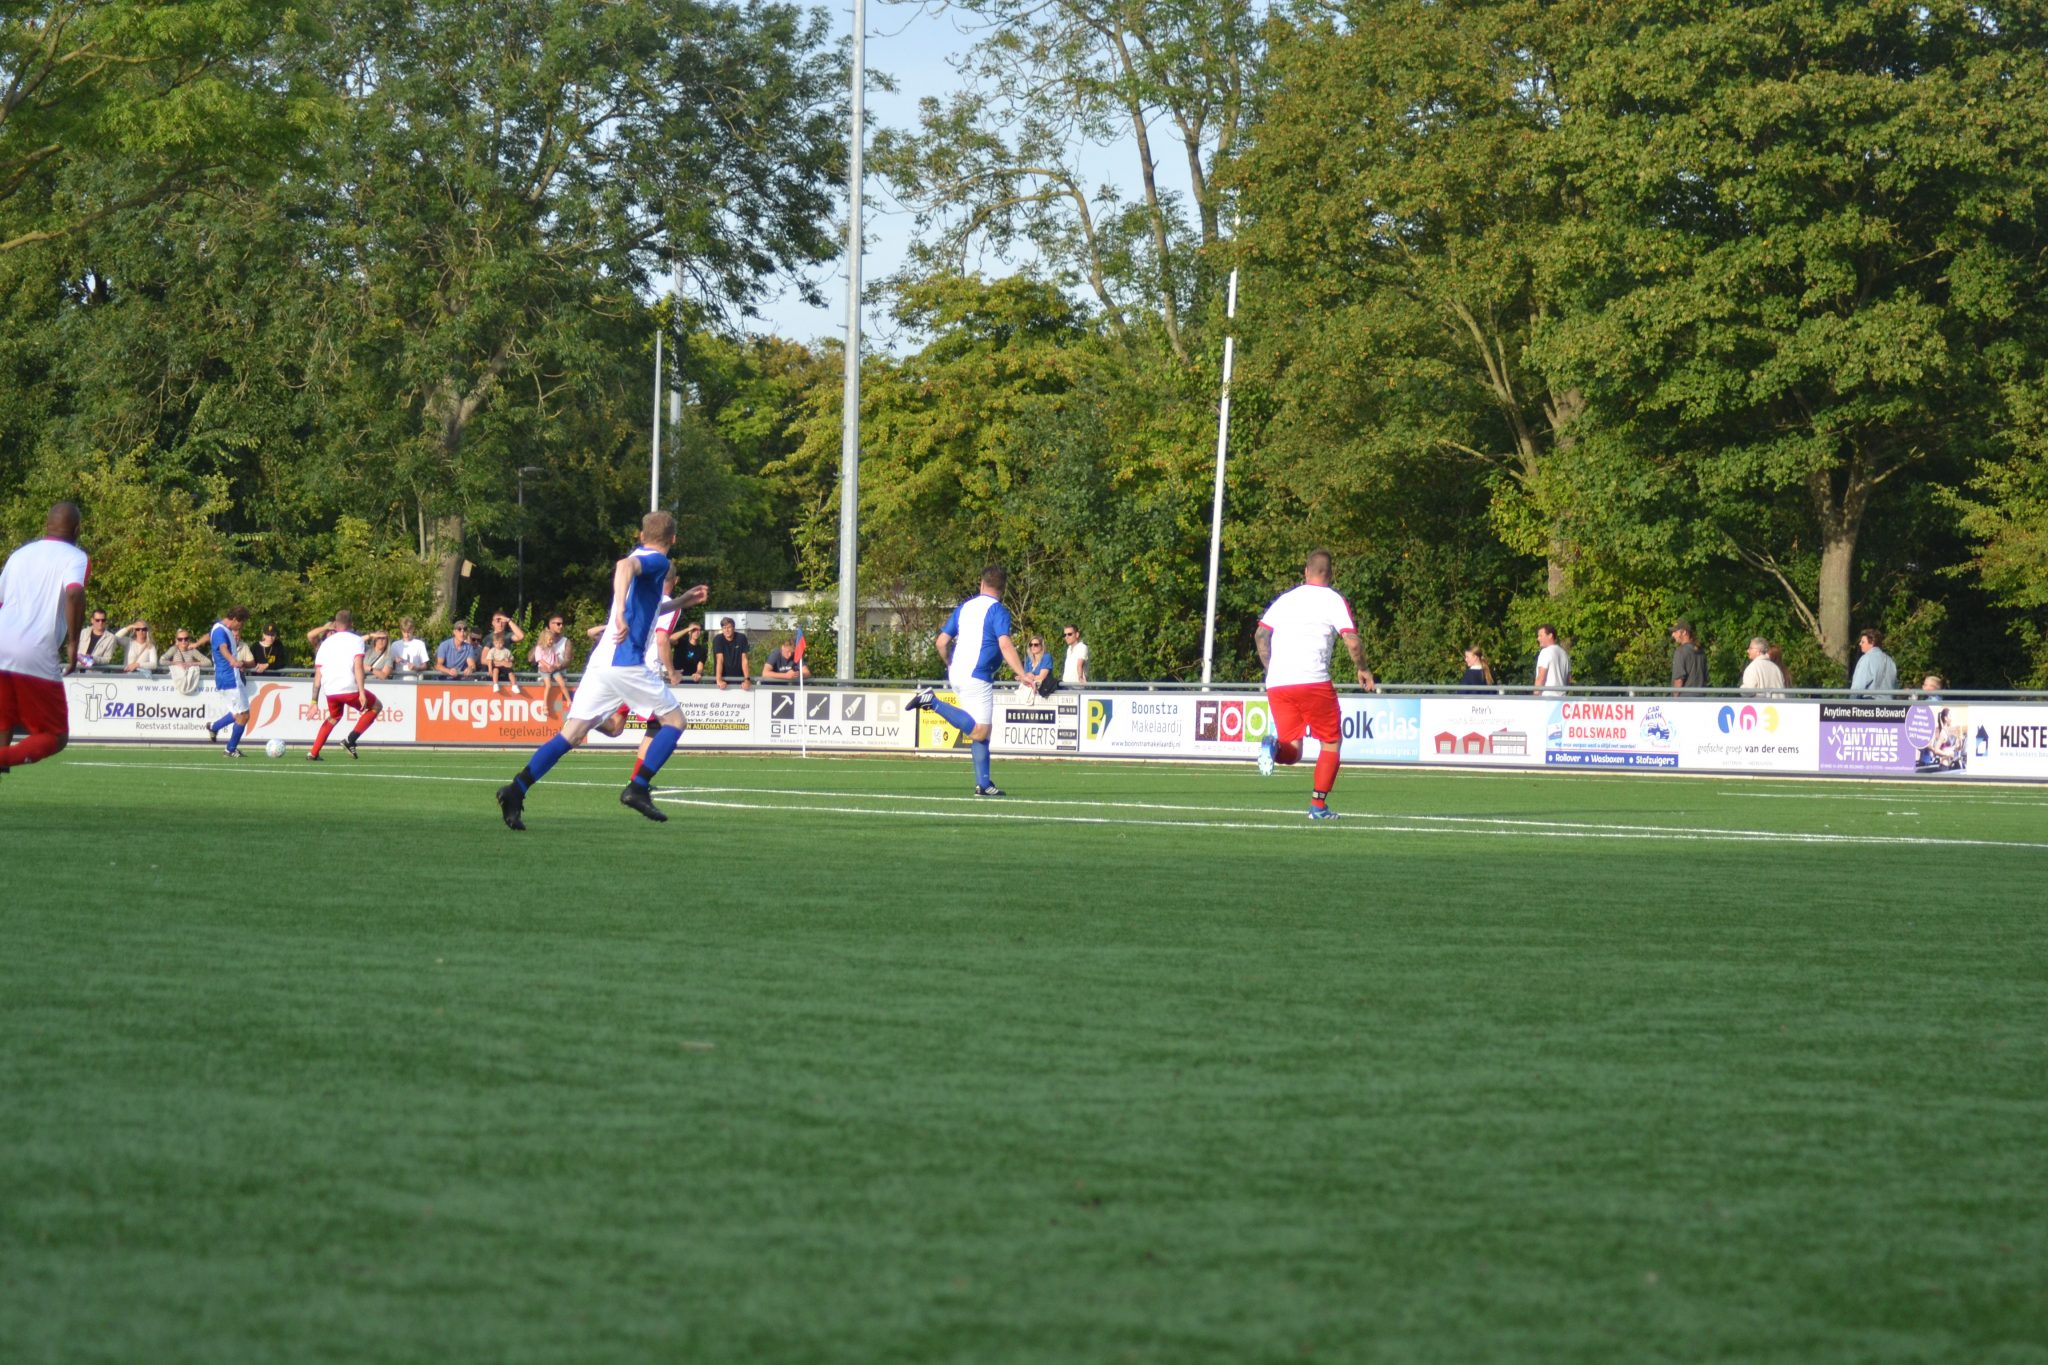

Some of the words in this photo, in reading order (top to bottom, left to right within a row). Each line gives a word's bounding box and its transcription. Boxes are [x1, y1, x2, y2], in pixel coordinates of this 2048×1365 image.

[347, 704, 404, 722] Eate
[424, 691, 548, 728] vlagsma
[1131, 701, 1178, 715] Boonstra
[1562, 703, 1635, 720] CARWASH
[1823, 707, 1851, 719] Anytime
[1852, 707, 1875, 718] Fitness
[1875, 707, 1906, 718] Bolsward
[1007, 712, 1054, 720] RESTAURANT
[1200, 706, 1267, 736] FOO
[136, 721, 171, 730] Roestvast
[771, 724, 843, 735] GIETEMA
[851, 725, 900, 737] BOUW
[1131, 719, 1182, 737] Makelaardij
[1568, 726, 1628, 740] BOLSWARD
[1004, 726, 1056, 746] FOLKERTS
[1843, 727, 1898, 747] ANYTIME
[1745, 744, 1760, 753] van
[1761, 744, 1775, 753] der
[1777, 745, 1799, 754] eems
[1843, 746, 1898, 763] FITNESS
[1555, 754, 1582, 763] Rollover
[1591, 755, 1625, 764] Wasboxen
[1635, 756, 1675, 767] Stofzuigers
